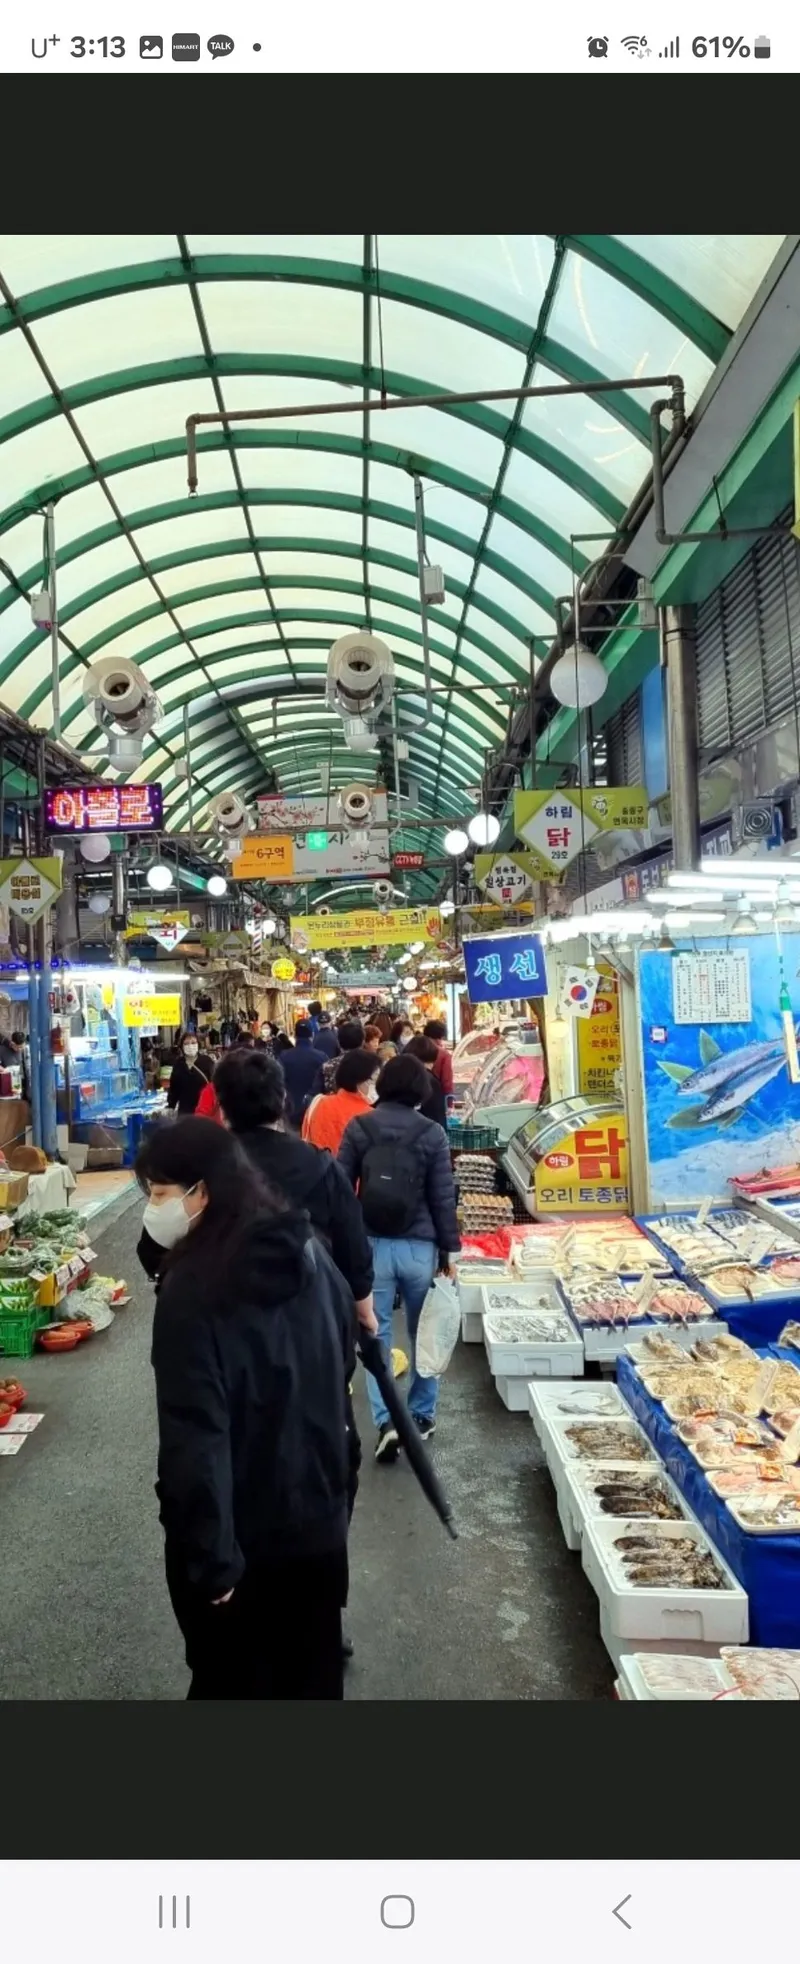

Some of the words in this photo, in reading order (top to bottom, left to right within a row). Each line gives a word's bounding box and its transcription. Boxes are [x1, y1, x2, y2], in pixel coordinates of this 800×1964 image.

[545, 805, 573, 819] 하림
[613, 816, 645, 826] 면목시장
[547, 827, 572, 847] 닭
[256, 846, 285, 860] 6구역
[474, 949, 540, 985] 생선
[574, 1128, 626, 1179] 닭
[549, 1156, 569, 1167] 하림
[540, 1187, 573, 1203] 오리
[578, 1187, 628, 1203] 토종닭
